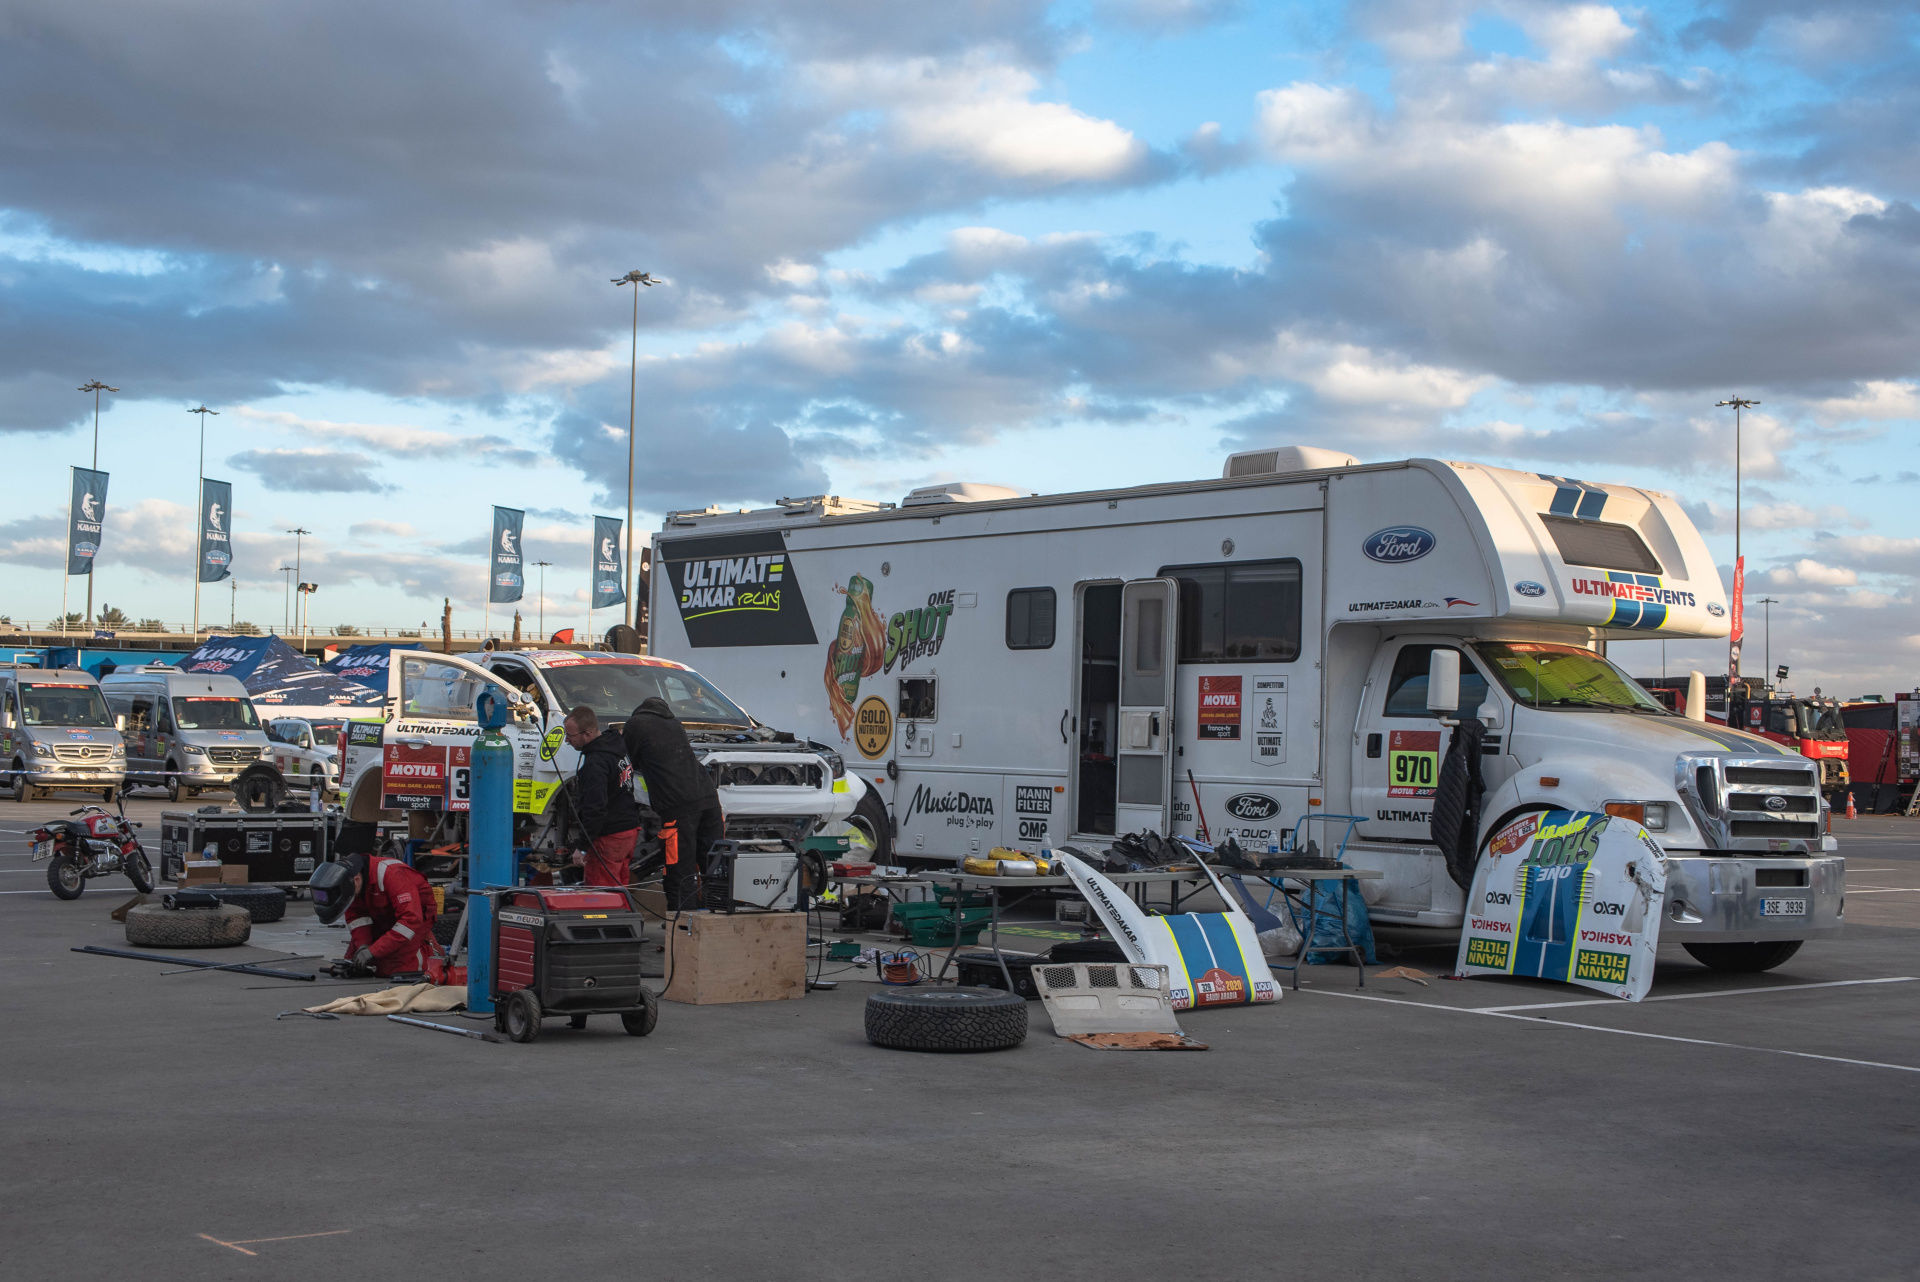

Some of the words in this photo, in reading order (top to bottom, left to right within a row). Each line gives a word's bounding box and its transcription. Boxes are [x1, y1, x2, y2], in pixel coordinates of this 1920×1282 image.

[77, 523, 101, 533] KAMAZ
[1375, 532, 1422, 558] Ford
[683, 555, 785, 588] ULTIMATE
[1521, 583, 1540, 594] Ford
[681, 587, 736, 609] DAKAR
[737, 584, 781, 612] racing
[927, 589, 956, 606] ONE
[1708, 605, 1724, 615] Ford
[884, 603, 955, 676] SHOT
[192, 647, 257, 662] KAMAZ
[336, 654, 390, 669] KAMA
[900, 637, 943, 672] energy
[1257, 681, 1284, 689] COMPETITOR
[1203, 695, 1237, 706] MOTUL
[861, 709, 886, 724] GOLD
[396, 724, 480, 736] ULTIMATEDAKA
[859, 724, 888, 735] NUTRITION
[1257, 736, 1281, 746] ULTIMATE
[1260, 746, 1279, 757] DAKAR
[390, 764, 438, 776] MOTUL
[1396, 755, 1432, 784] 970
[1017, 788, 1051, 800] MANN
[1391, 787, 1415, 795] MOTUL
[411, 801, 430, 809] sport
[1017, 800, 1051, 812] FILTER
[1174, 801, 1190, 812] oto
[1235, 796, 1270, 817] Ford
[946, 816, 964, 828] plug
[975, 817, 994, 830] play
[1174, 812, 1192, 822] udio
[1019, 821, 1048, 838] OMP
[1535, 815, 1592, 840] energy
[1519, 815, 1612, 868] SHOT
[1535, 866, 1572, 882] ONE
[753, 874, 780, 889] ewm
[1486, 891, 1512, 905] NEXO
[1593, 901, 1626, 916] NEXO
[1766, 901, 1781, 914] 3SE
[1785, 901, 1804, 914] 3939
[1471, 918, 1513, 933] YASHICA
[1580, 929, 1633, 947] YASHICA
[1470, 939, 1508, 955] FILTER
[1468, 951, 1506, 967] MANN
[1580, 951, 1628, 969] FILTER
[1578, 964, 1626, 982] MANN
[1225, 980, 1243, 992] 2020
[1254, 982, 1272, 991] LIQUI
[1206, 993, 1220, 1001] SAUDI
[1220, 991, 1238, 1000] ARABIA
[1256, 991, 1274, 1000] MOLY
